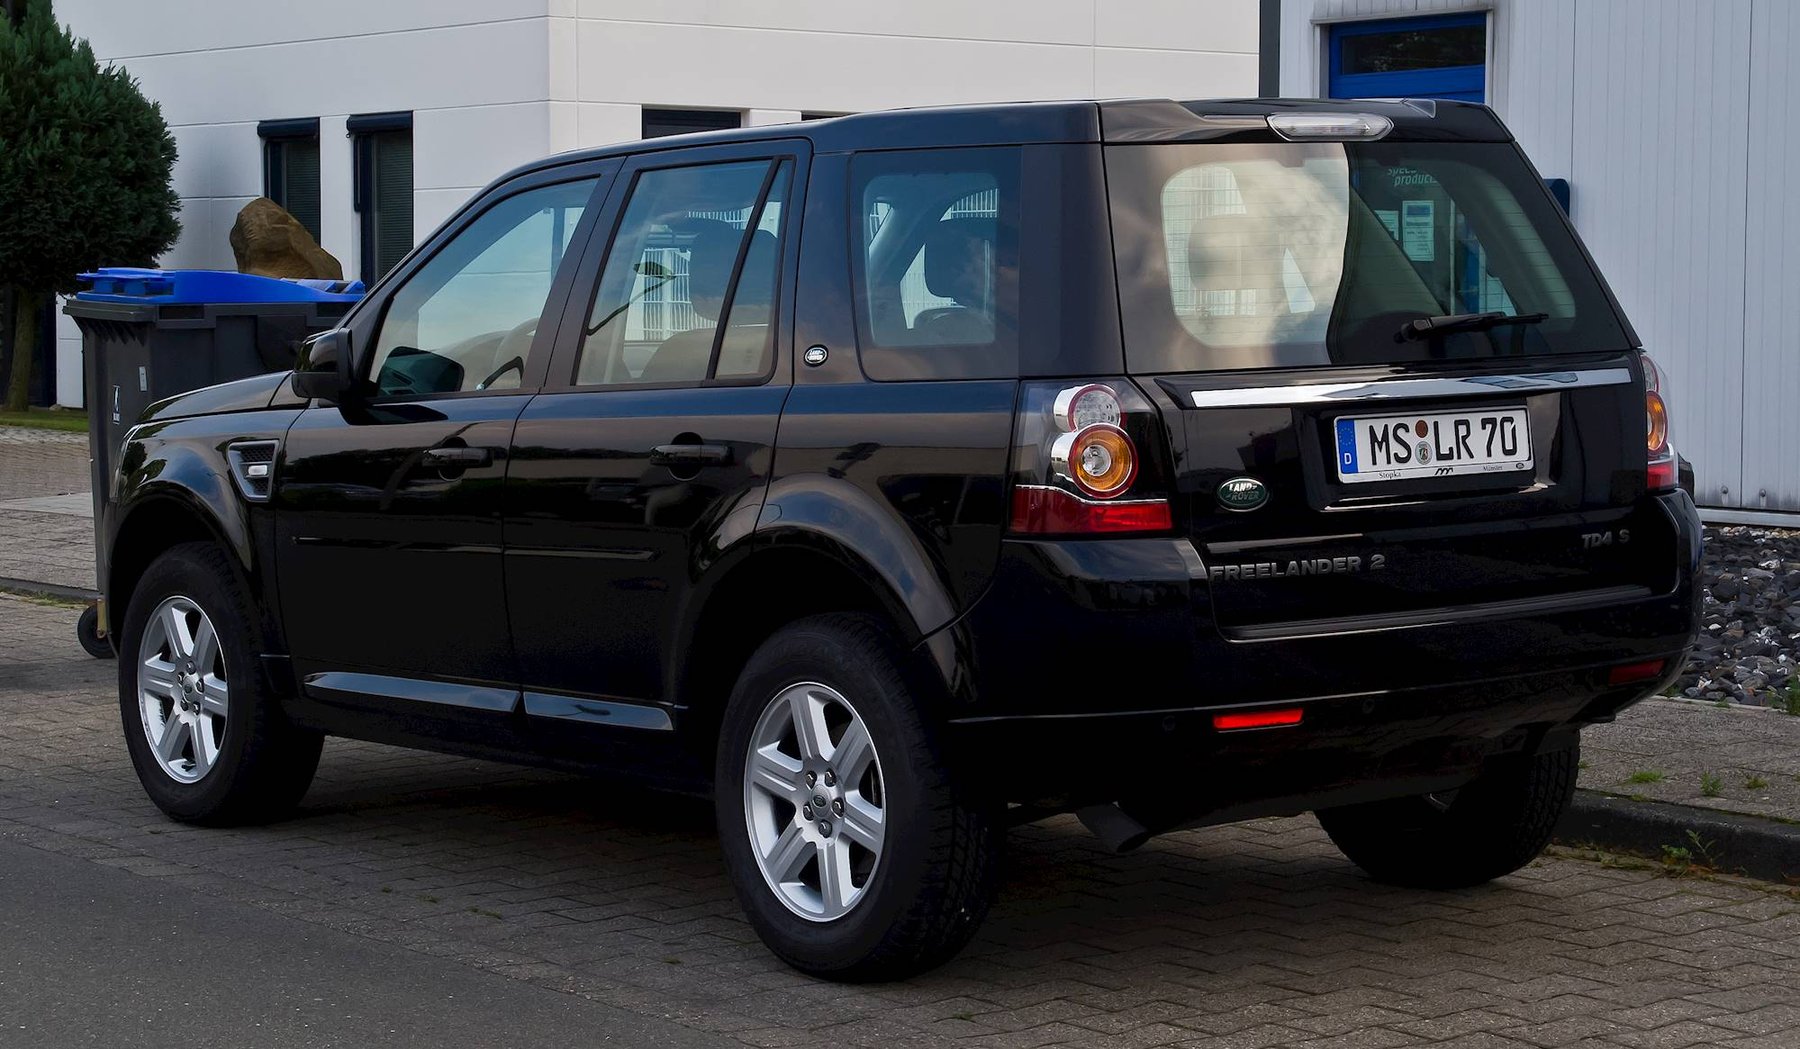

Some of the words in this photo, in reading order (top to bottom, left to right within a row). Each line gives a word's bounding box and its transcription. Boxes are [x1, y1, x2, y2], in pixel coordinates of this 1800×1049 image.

[1368, 422, 1412, 466] MS
[1432, 418, 1475, 461] LR
[1480, 416, 1518, 458] 70
[1344, 452, 1352, 465] D
[1229, 482, 1253, 492] LAND
[1581, 531, 1613, 550] TD4
[1619, 529, 1630, 544] S
[1208, 555, 1362, 582] FREELANDER
[1370, 554, 1386, 570] 2
